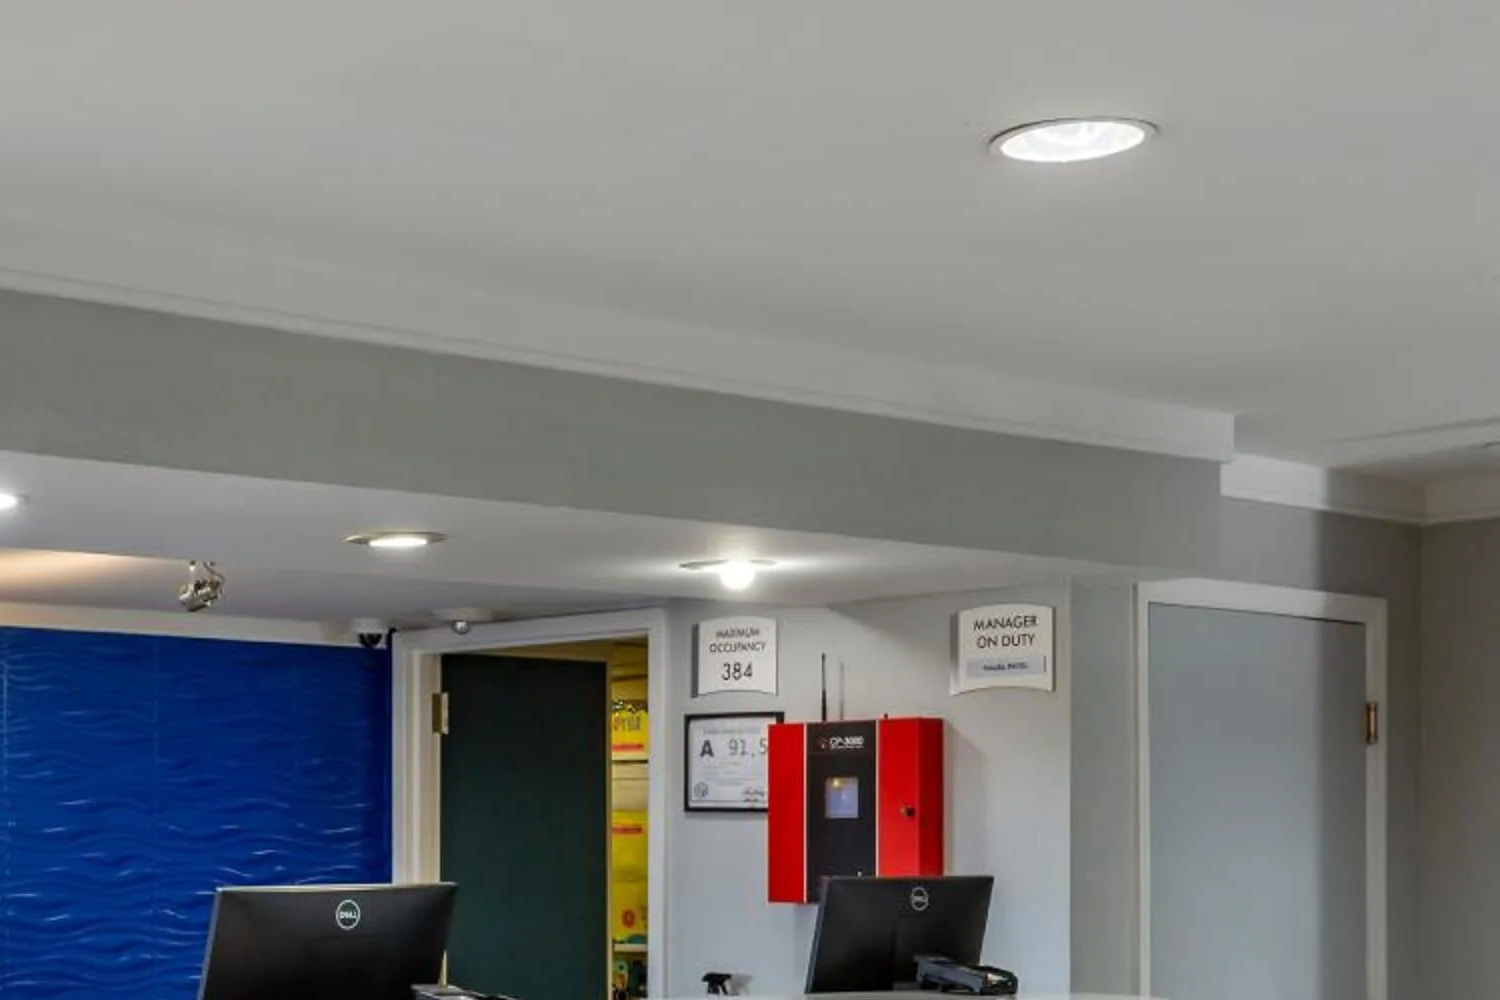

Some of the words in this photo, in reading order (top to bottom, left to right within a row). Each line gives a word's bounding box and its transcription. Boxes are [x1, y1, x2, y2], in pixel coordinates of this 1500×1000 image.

[974, 615, 1037, 631] MANAGER
[709, 641, 767, 653] OCCUPANCY
[976, 635, 998, 649] ON
[1002, 633, 1035, 648] DUTY
[722, 662, 753, 681] 384
[700, 738, 714, 758] A
